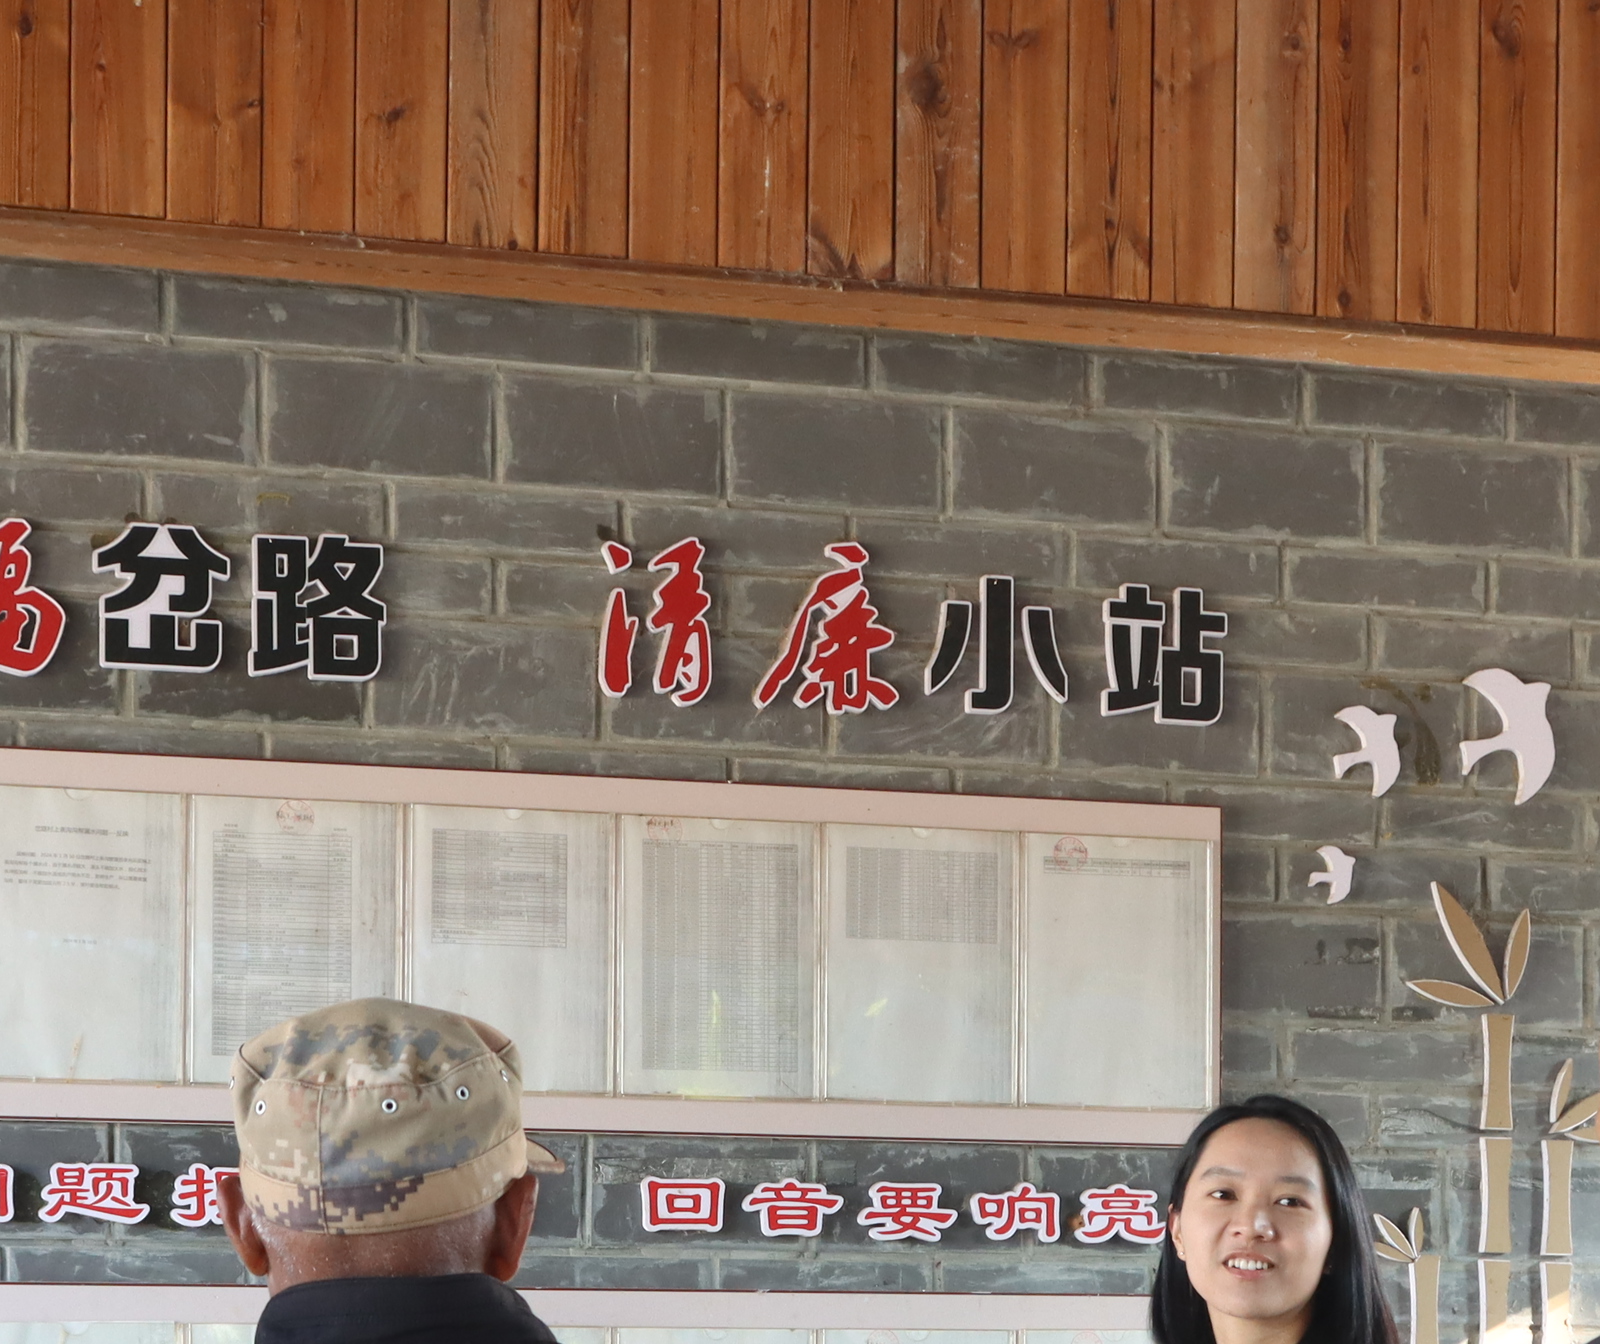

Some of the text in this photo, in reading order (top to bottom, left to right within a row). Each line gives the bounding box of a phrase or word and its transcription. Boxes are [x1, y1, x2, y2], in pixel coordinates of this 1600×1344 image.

[598, 536, 1228, 726] 清廉小站
[648, 1181, 1166, 1239] 回音要响亮
